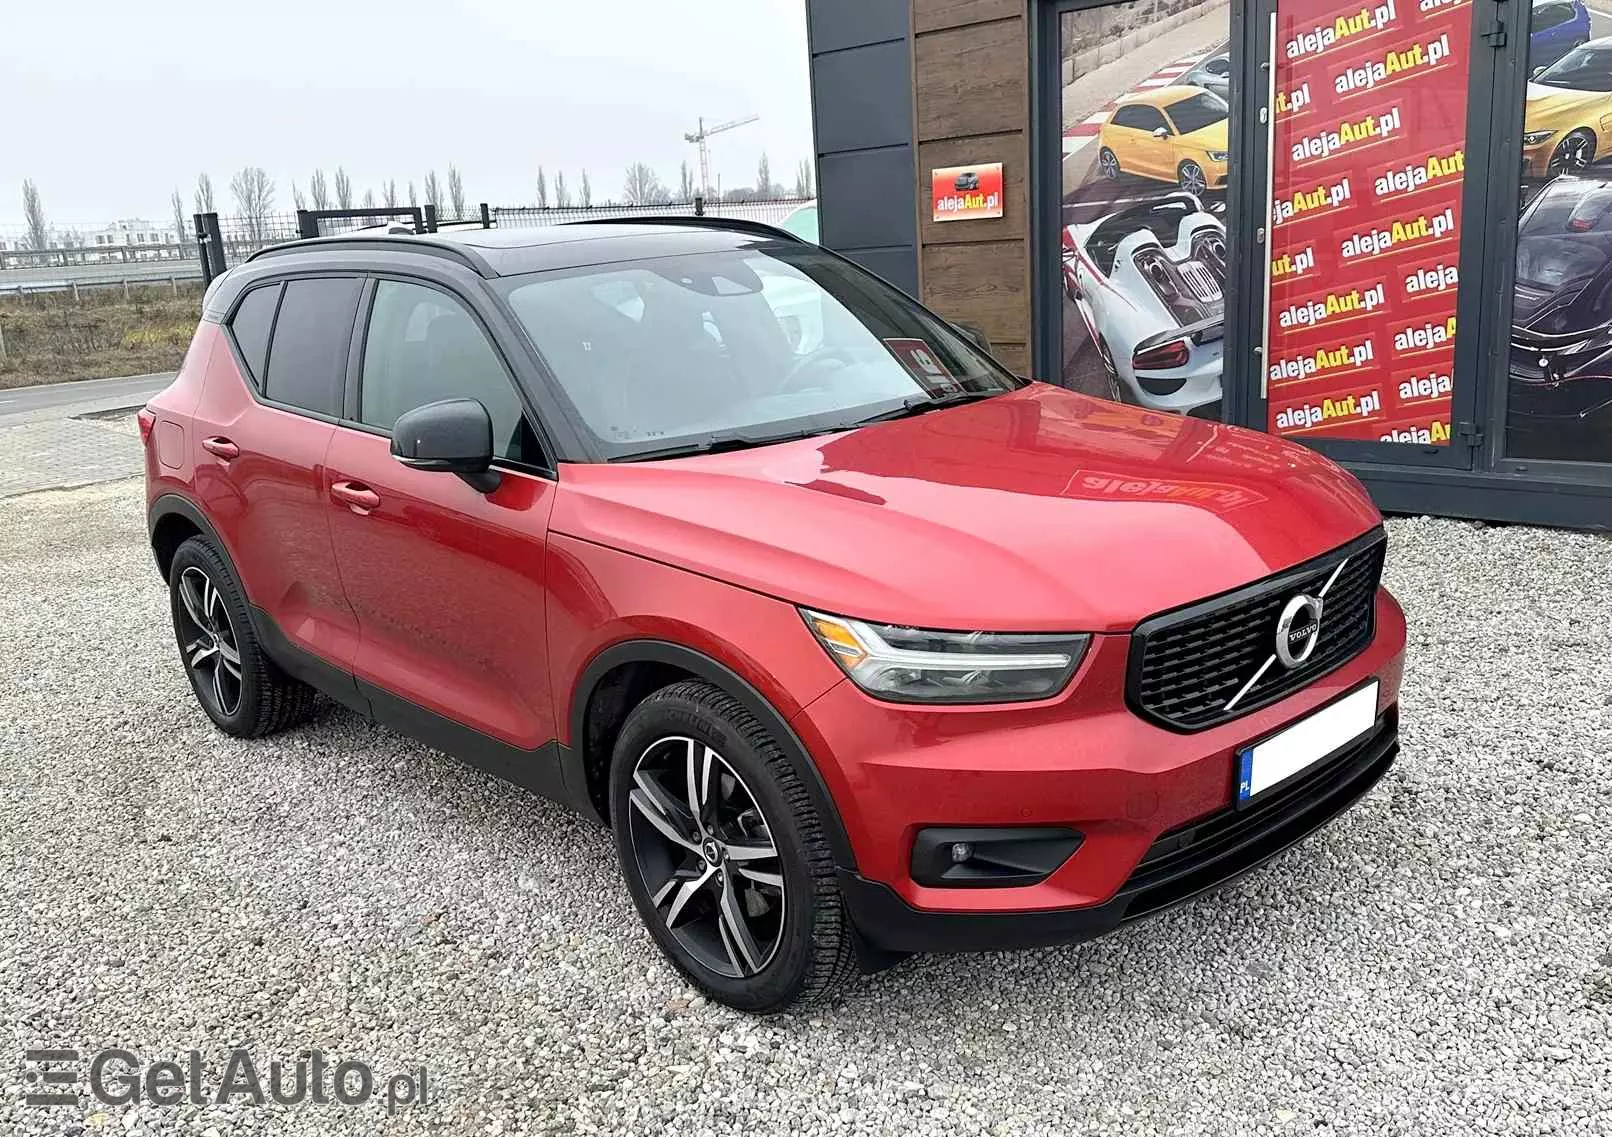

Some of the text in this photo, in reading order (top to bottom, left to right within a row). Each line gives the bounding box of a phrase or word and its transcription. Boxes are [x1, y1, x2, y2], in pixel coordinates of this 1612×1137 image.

[1286, 1, 1396, 58] alejaAut.pl
[1335, 34, 1450, 94] alejaAut.pl
[1292, 108, 1401, 161] alejaAut.pl
[1375, 150, 1464, 196] alejaAut
[937, 192, 999, 212] alejaAut.pl
[1341, 208, 1454, 258] alejaAut.pl
[1405, 264, 1458, 293] aleja
[1279, 284, 1385, 328] alejaAut.pl
[1269, 340, 1374, 380] alejaAut.pl
[1276, 391, 1380, 428] alejaAut.pl
[1289, 623, 1317, 641] VOLVO
[1240, 780, 1250, 793] PL
